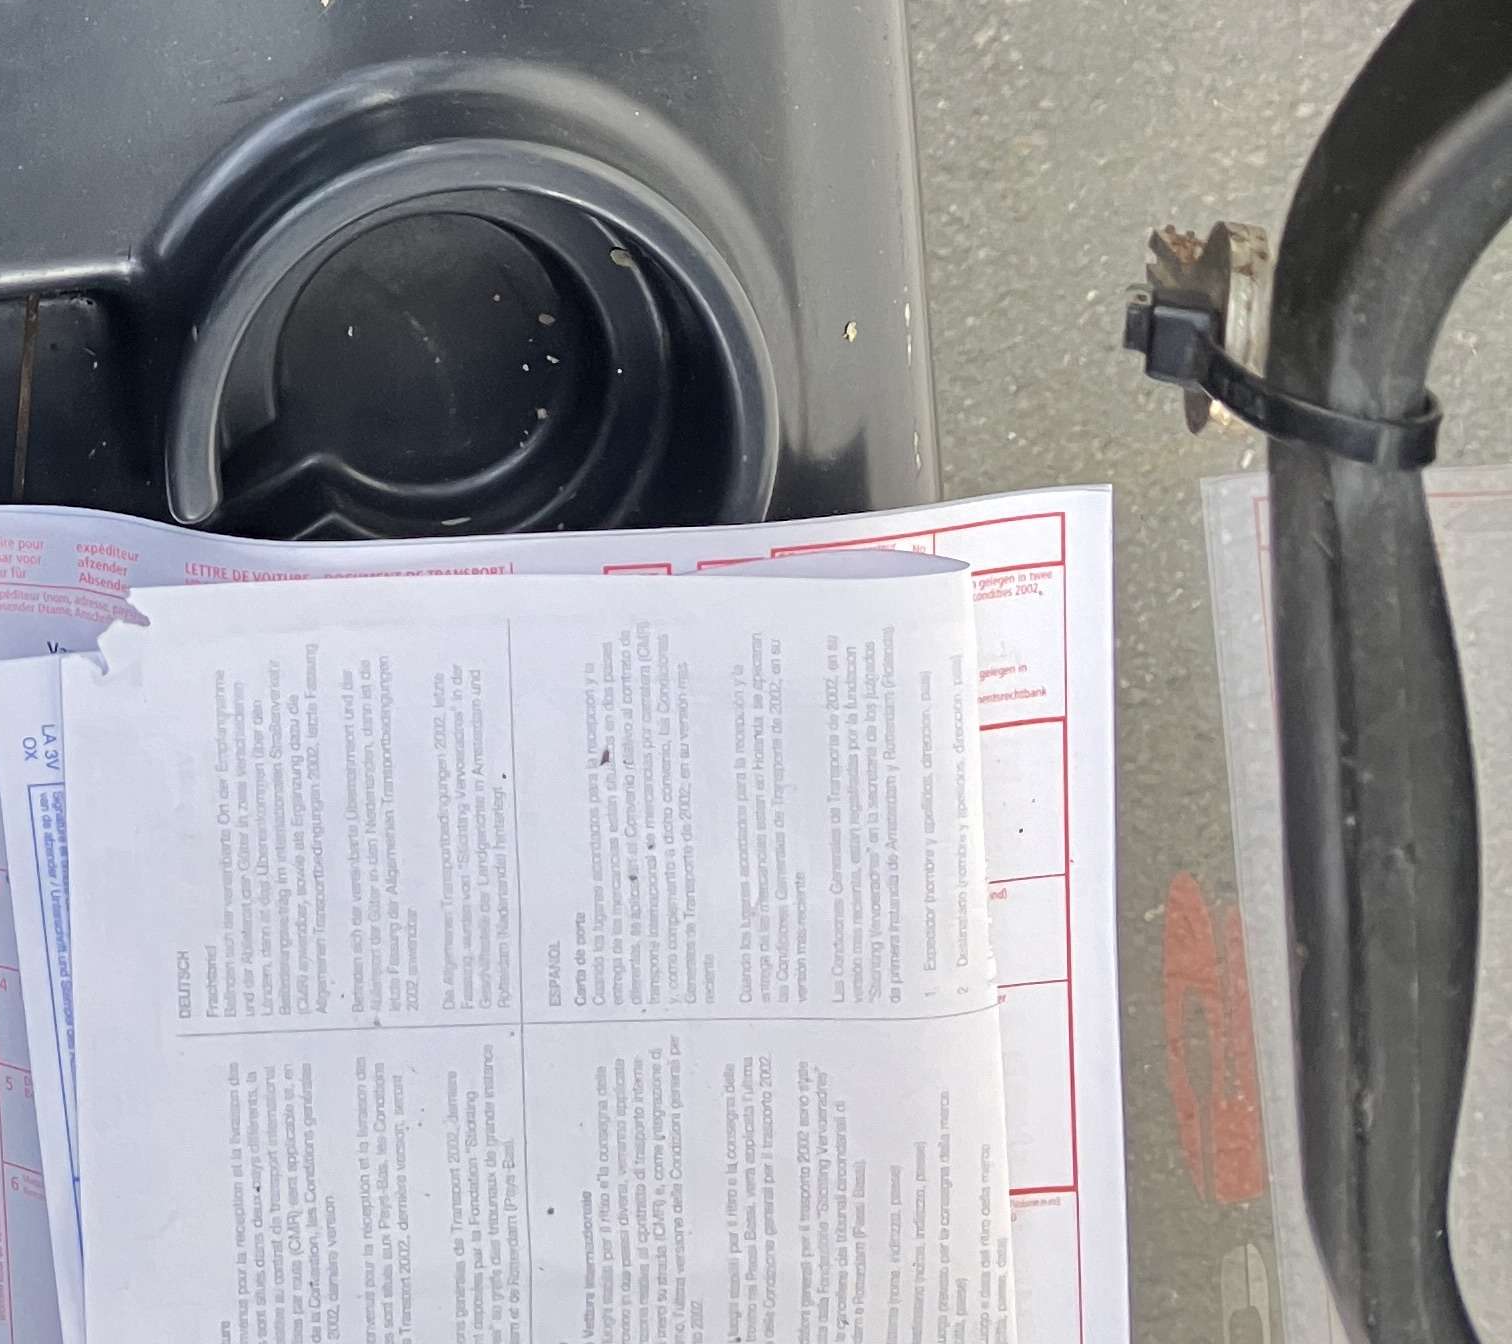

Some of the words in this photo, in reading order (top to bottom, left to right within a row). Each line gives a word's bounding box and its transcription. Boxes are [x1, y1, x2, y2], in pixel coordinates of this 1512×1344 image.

[17, 539, 44, 552] pour
[76, 543, 138, 562] expéditeur
[77, 556, 127, 577] afzender
[184, 562, 228, 580] LETTRE
